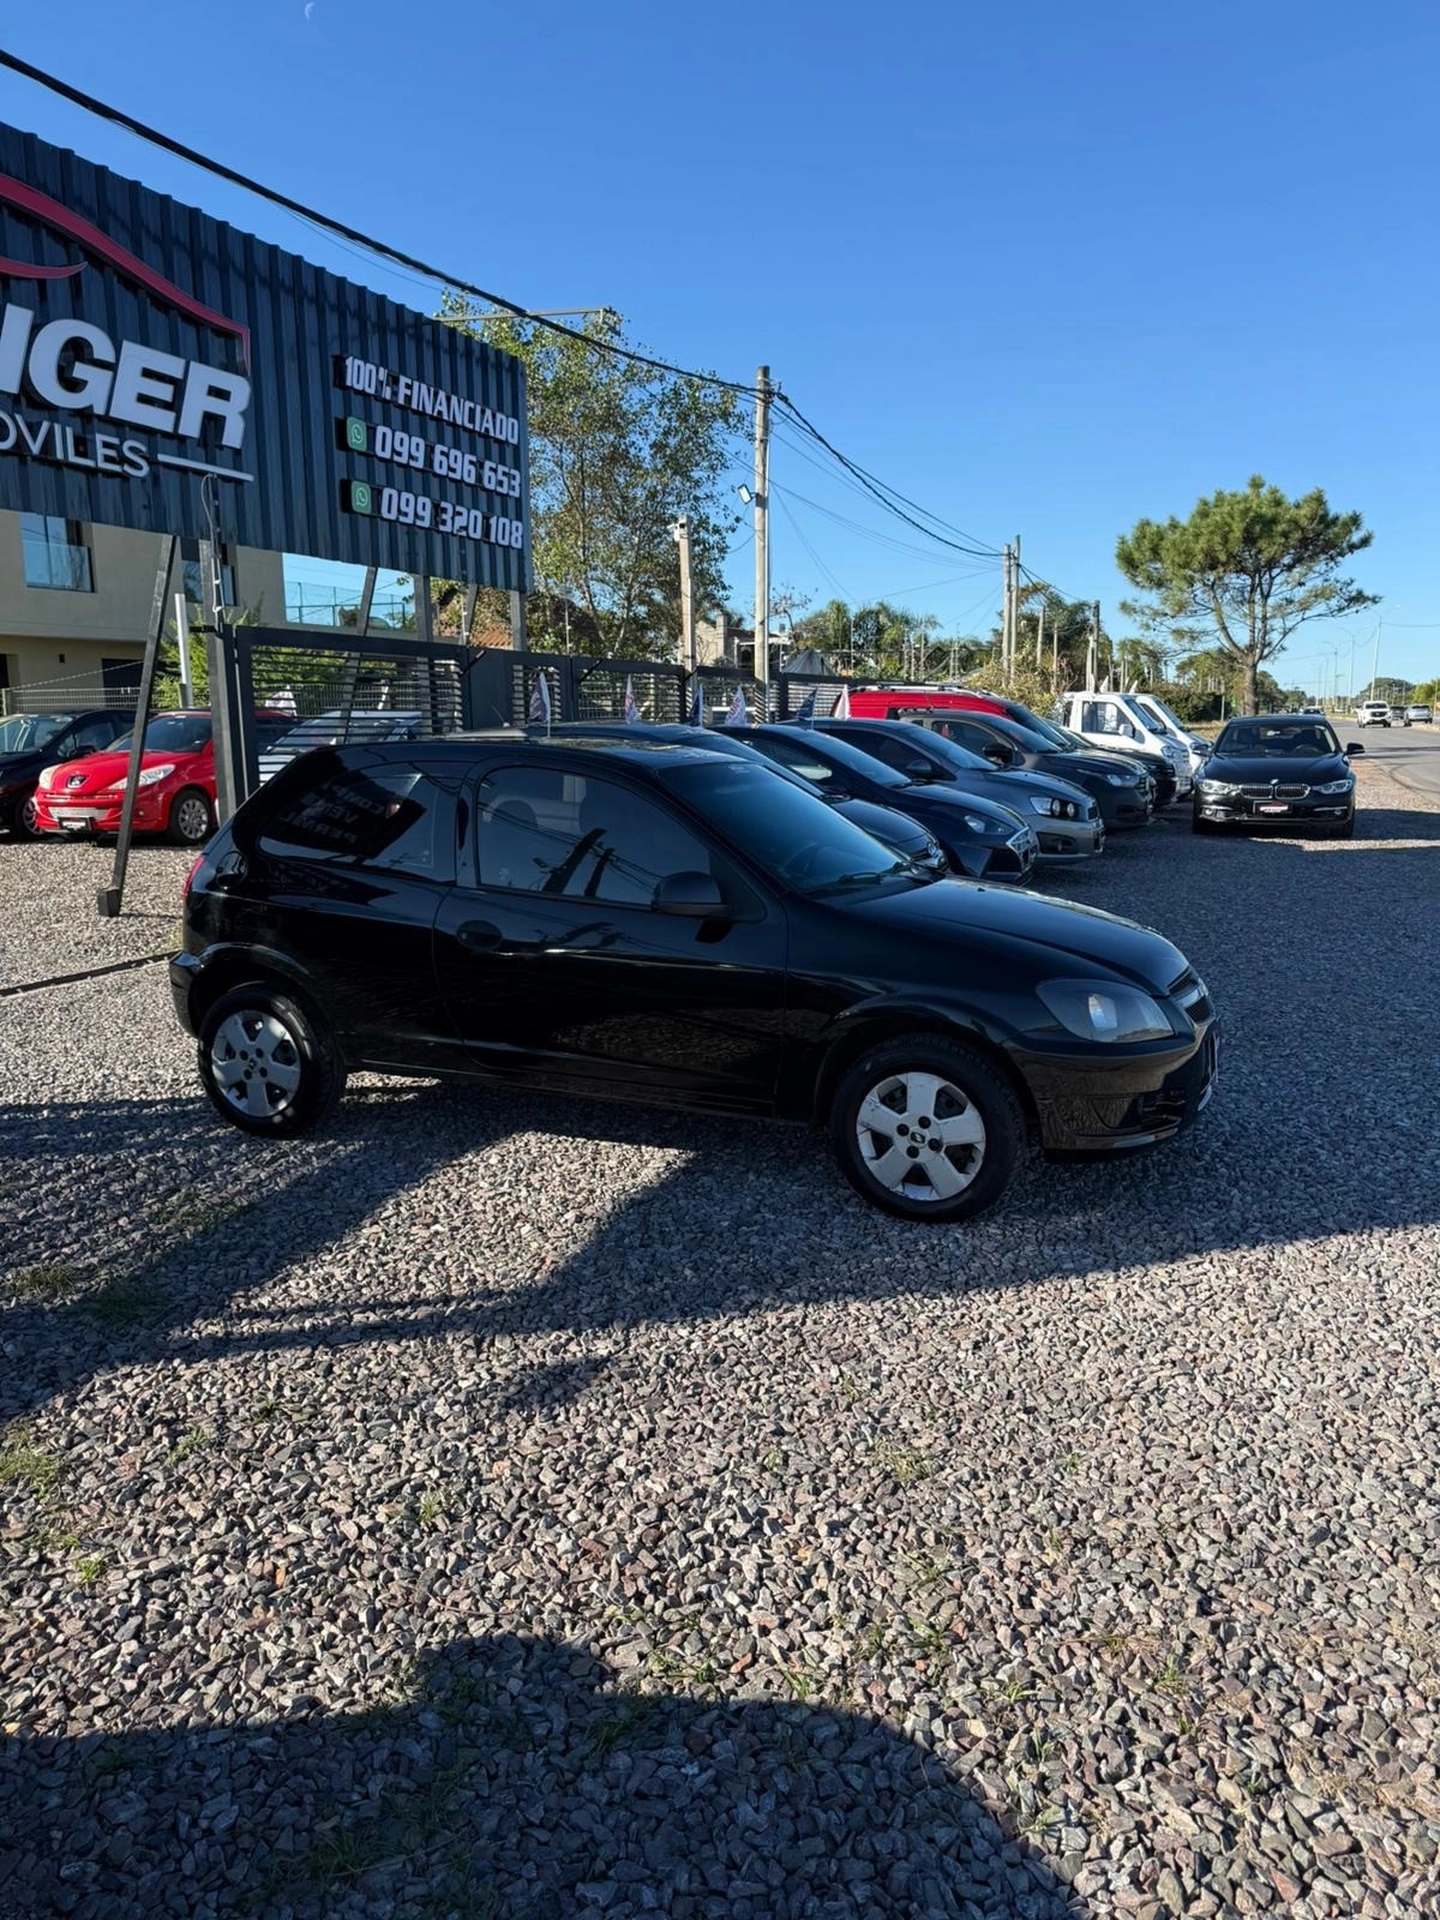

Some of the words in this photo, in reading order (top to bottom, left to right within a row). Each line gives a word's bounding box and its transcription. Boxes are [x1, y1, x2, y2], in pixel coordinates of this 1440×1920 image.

[345, 356, 391, 400] 100%
[398, 375, 519, 446] FINANCIADO
[374, 425, 425, 469] 099
[433, 444, 478, 485] 696
[483, 460, 521, 498] 653
[381, 487, 432, 528] 099
[439, 501, 483, 540] 320
[489, 515, 523, 549] 108
